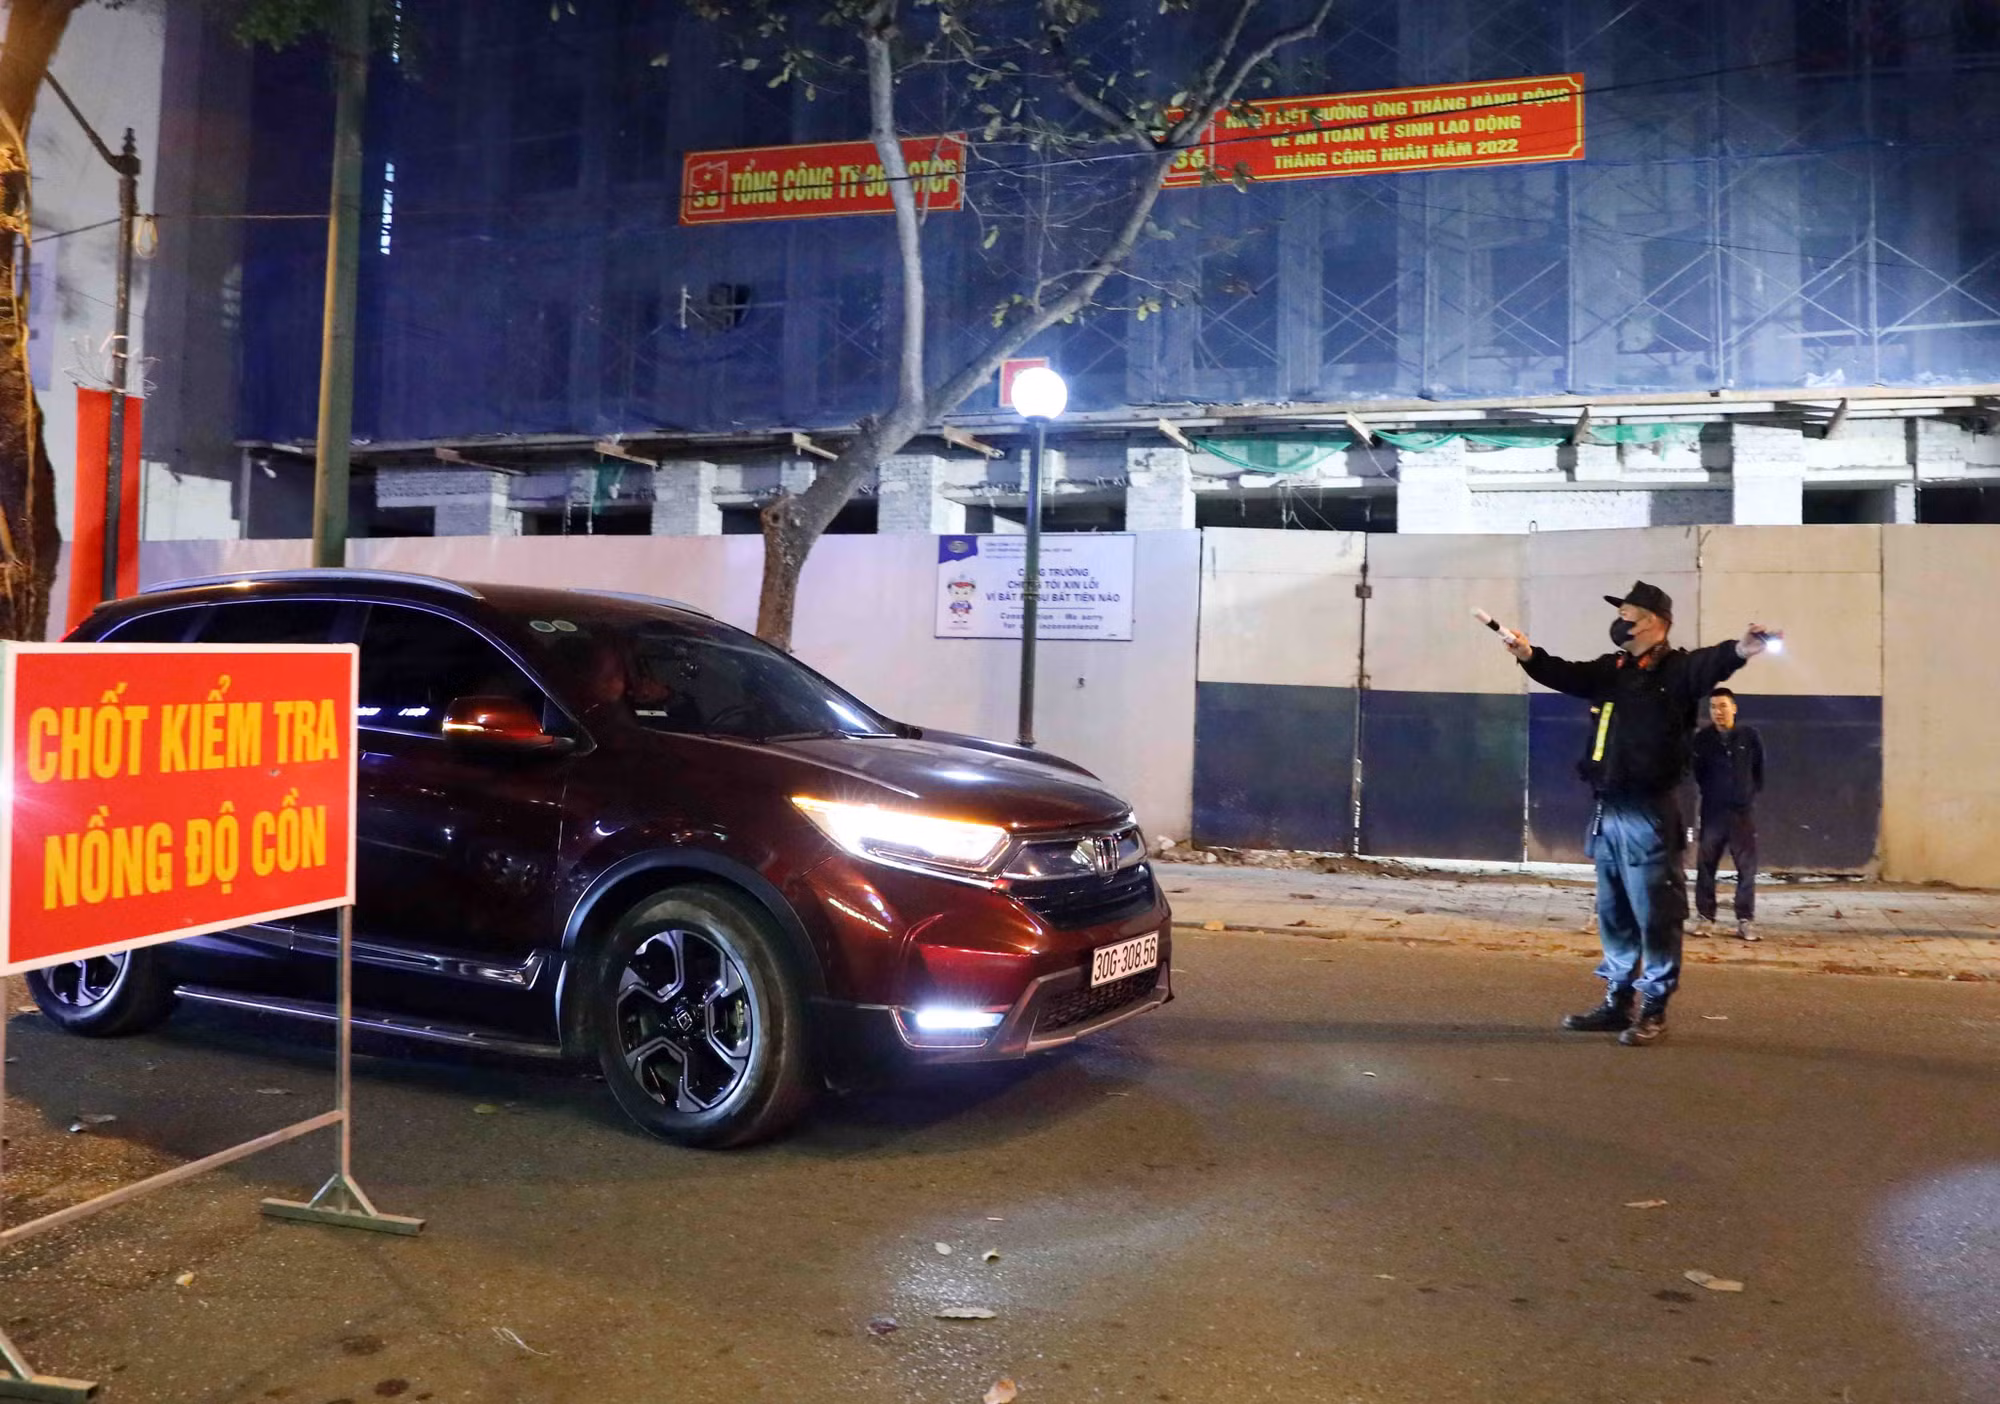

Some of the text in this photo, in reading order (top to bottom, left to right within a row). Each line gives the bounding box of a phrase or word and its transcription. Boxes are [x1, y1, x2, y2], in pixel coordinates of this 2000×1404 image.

[1373, 100, 1408, 118] ỨNG
[1412, 95, 1467, 114] THÁNG
[1471, 90, 1518, 108] HÀNH
[1522, 87, 1570, 107] ĐỘNG
[1294, 131, 1318, 146] AN
[1369, 123, 1390, 142] VỆ
[1394, 121, 1435, 139] SINH
[1439, 118, 1470, 135] LAO
[1273, 138, 1519, 169] THÁNG CÔNG NHÂN NĂM 2022
[731, 159, 778, 206] TỔNG
[782, 161, 834, 203] CÔNG
[839, 164, 861, 199] TY
[1063, 580, 1081, 589] XIN
[27, 674, 339, 785] CHỐT KIỂM TRA
[44, 787, 327, 911] NỒNG ĐỘ CỒN
[1094, 936, 1157, 982] 30G-308.56
